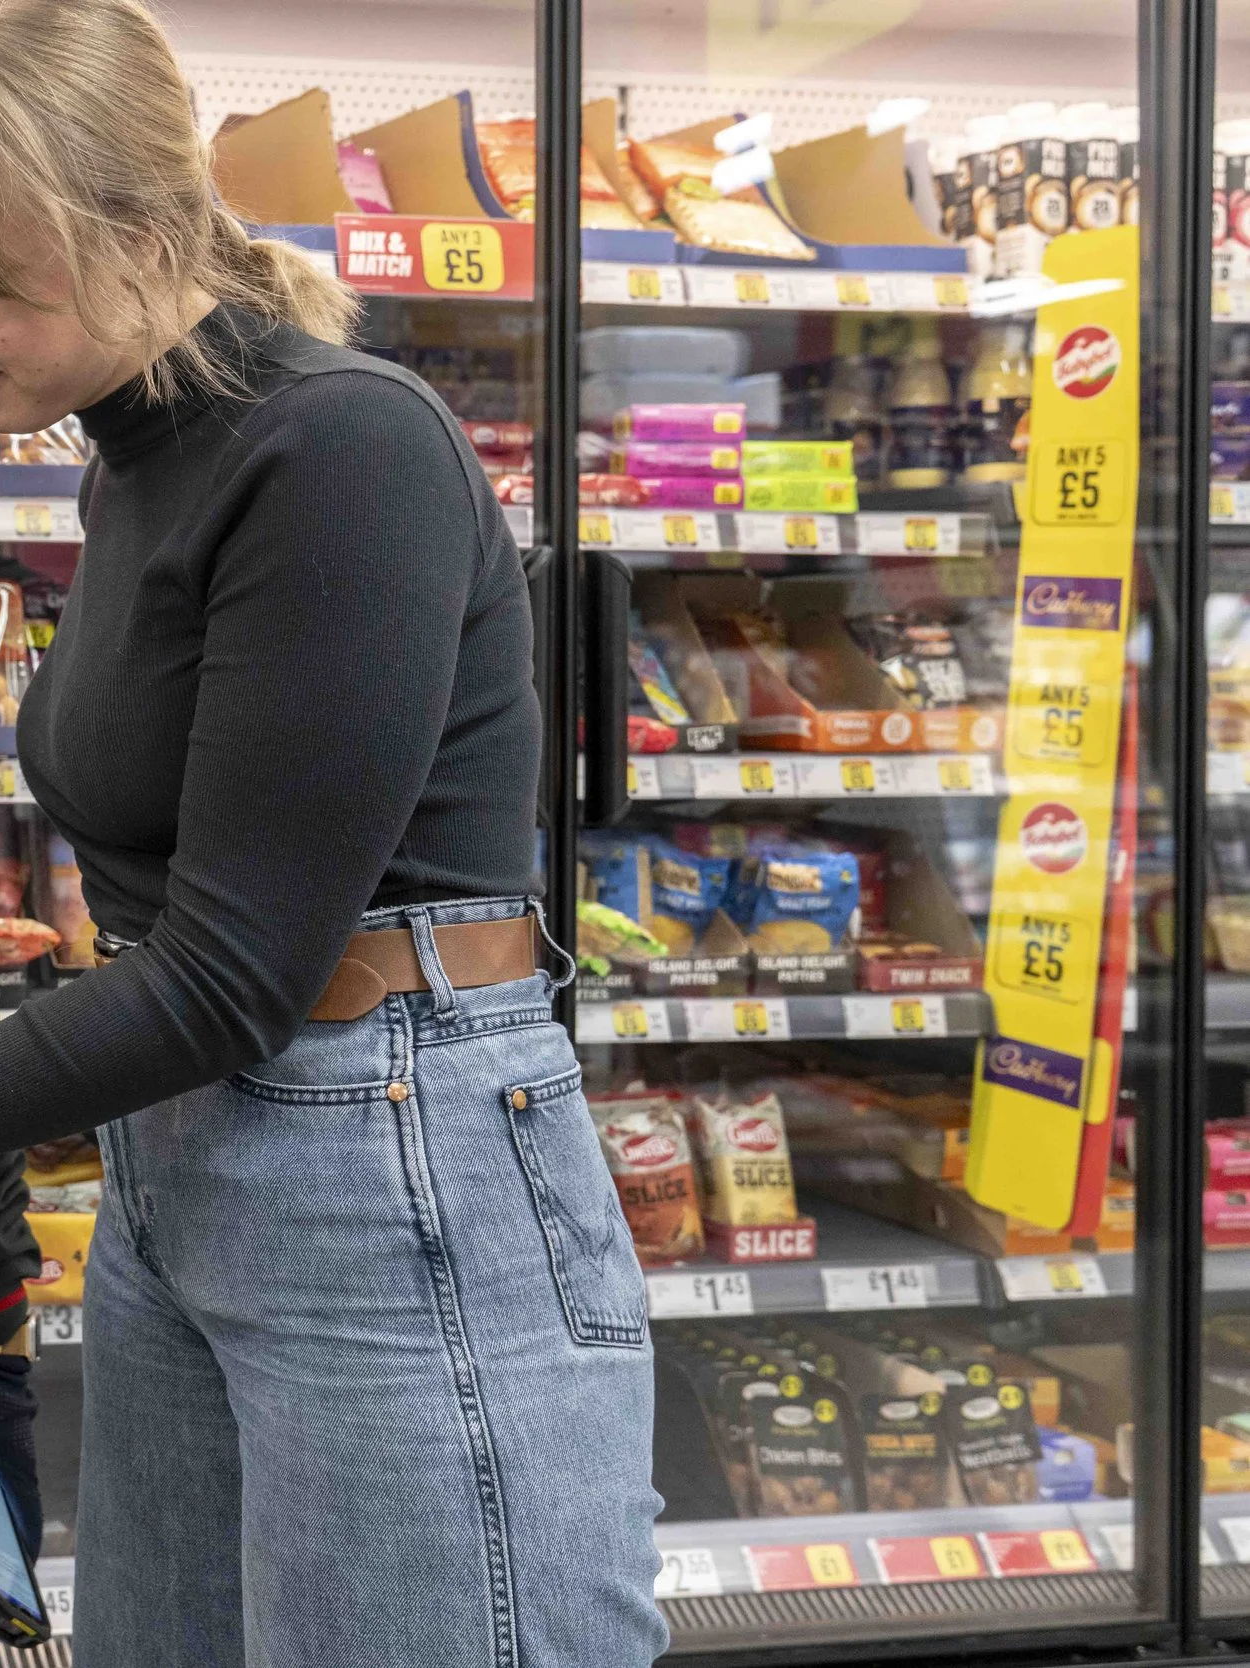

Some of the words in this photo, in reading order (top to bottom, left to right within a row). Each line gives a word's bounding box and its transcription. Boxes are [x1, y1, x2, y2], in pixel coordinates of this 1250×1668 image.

[349, 230, 387, 253] MIX
[388, 231, 406, 254] &
[441, 230, 470, 244] ANY
[347, 254, 413, 277] MATCH
[445, 249, 483, 284] £5
[1056, 447, 1092, 466] ANY
[1095, 446, 1106, 466] 5
[1058, 471, 1100, 509] £5
[1026, 581, 1116, 626] Cadbury
[1040, 683, 1075, 705] ANY
[1078, 686, 1090, 706] 5
[1042, 707, 1083, 748] £5
[1020, 915, 1055, 936] ANY
[1060, 923, 1071, 943] 5
[1023, 941, 1063, 982] £5
[891, 969, 926, 985] TWIN
[929, 967, 972, 983] SNACK
[989, 1042, 1078, 1100] Cadbury
[625, 1178, 688, 1204] SLICE
[733, 1167, 789, 1187] SLICE
[734, 1229, 814, 1258] SLICE
[693, 1275, 745, 1311] £1.45
[868, 1269, 918, 1303] £1.45
